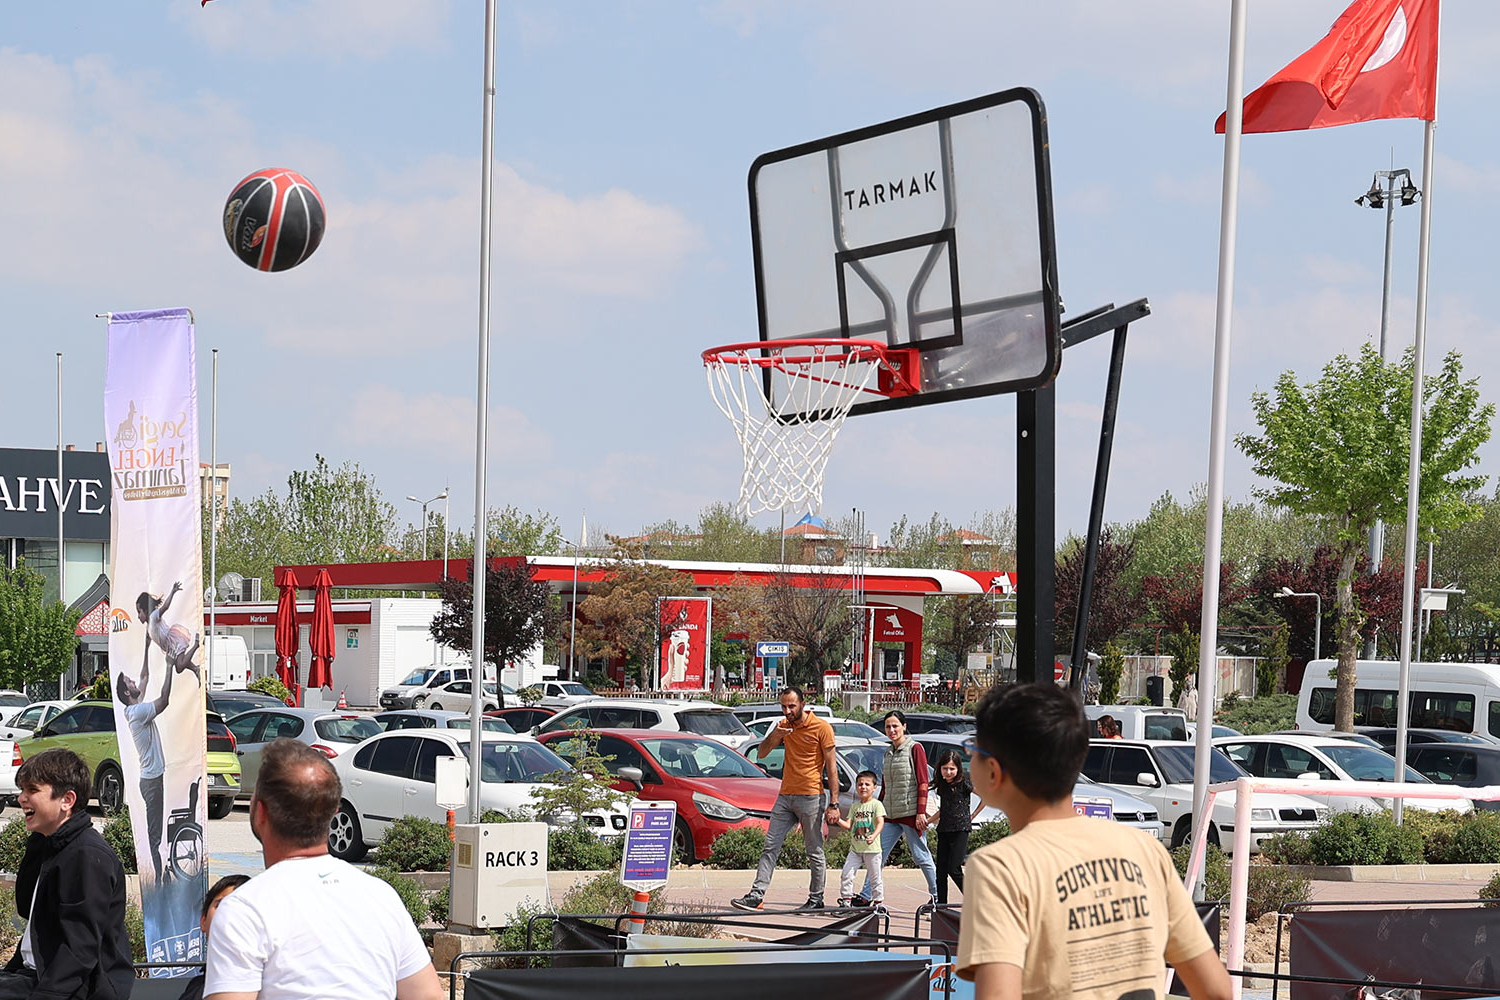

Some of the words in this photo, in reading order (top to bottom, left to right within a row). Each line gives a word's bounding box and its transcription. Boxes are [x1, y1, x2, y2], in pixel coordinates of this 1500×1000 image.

[844, 171, 937, 210] TARMAK
[250, 615, 268, 623] Market
[485, 851, 526, 867] RACK
[530, 851, 539, 866] 3
[1056, 857, 1146, 903] SURVIVOR
[1068, 895, 1150, 931] ATHLETIC
